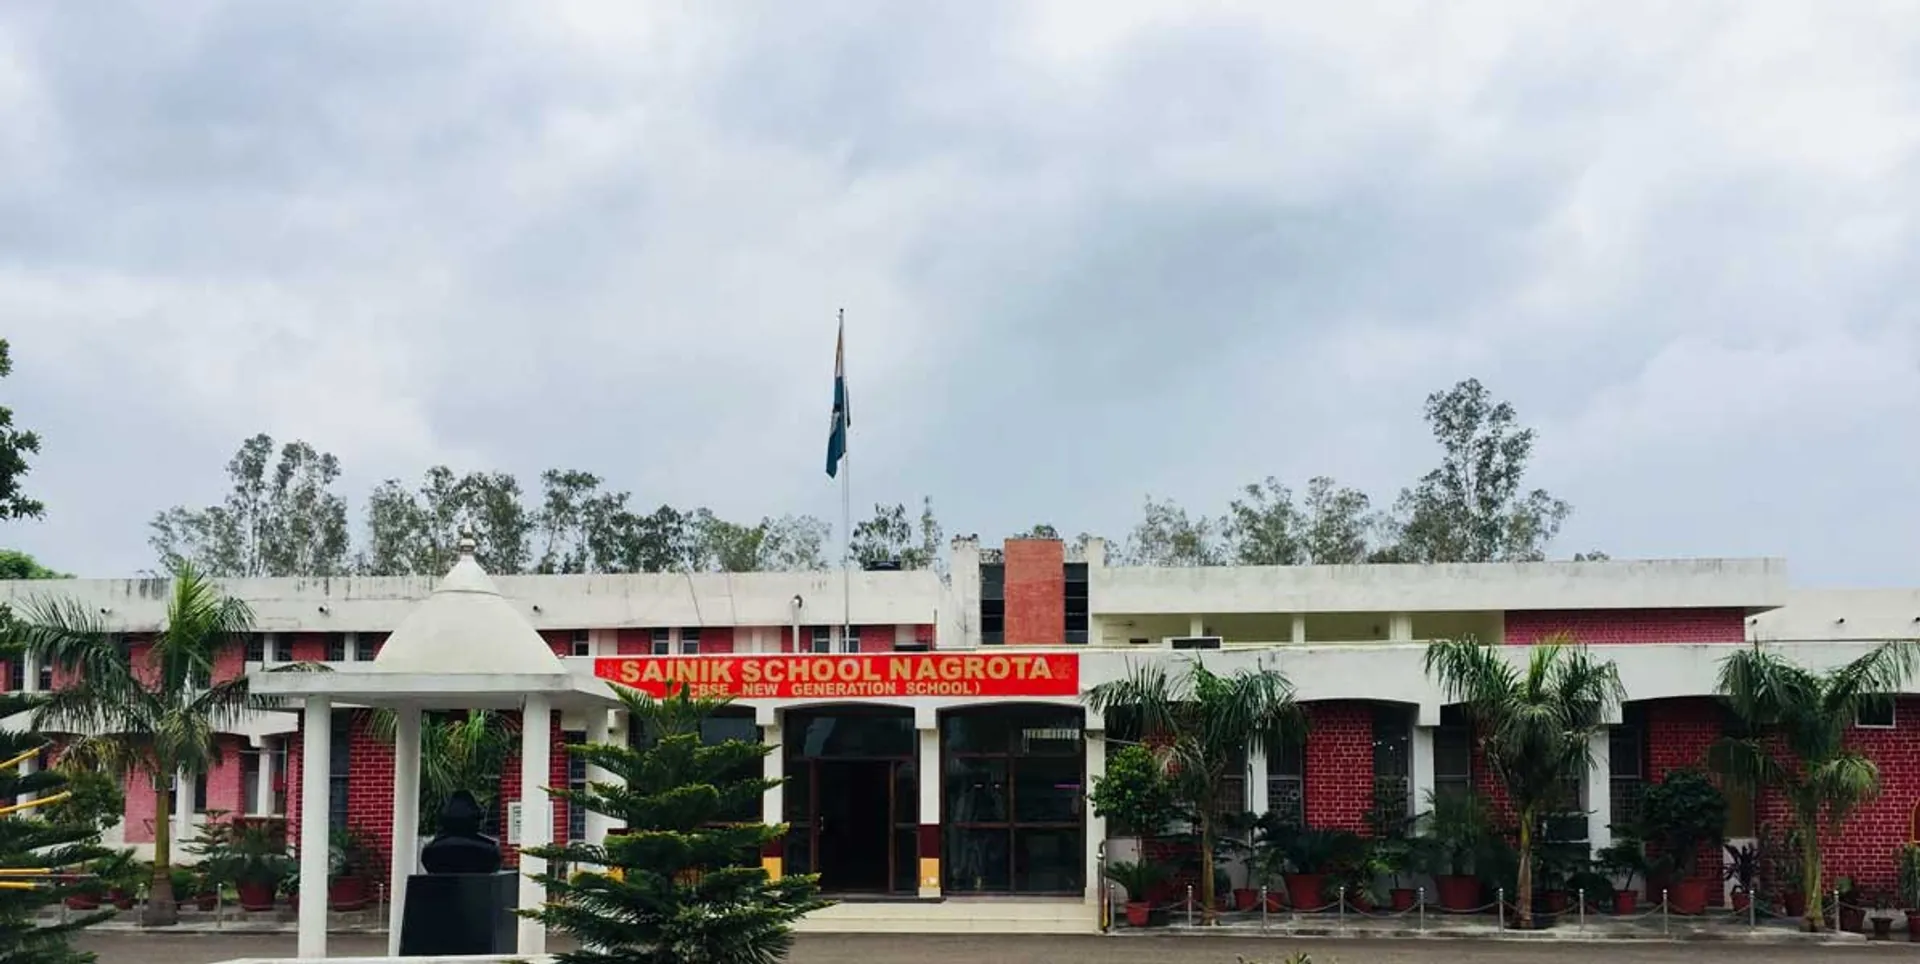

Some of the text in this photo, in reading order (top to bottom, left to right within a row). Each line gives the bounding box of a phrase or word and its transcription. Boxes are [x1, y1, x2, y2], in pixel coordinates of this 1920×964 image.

[620, 655, 1053, 683] SAINIK SCHOOL NAGROTA
[742, 683, 779, 696] NEW
[791, 682, 896, 696] GENERATION
[906, 680, 981, 696] SCHOOL)
